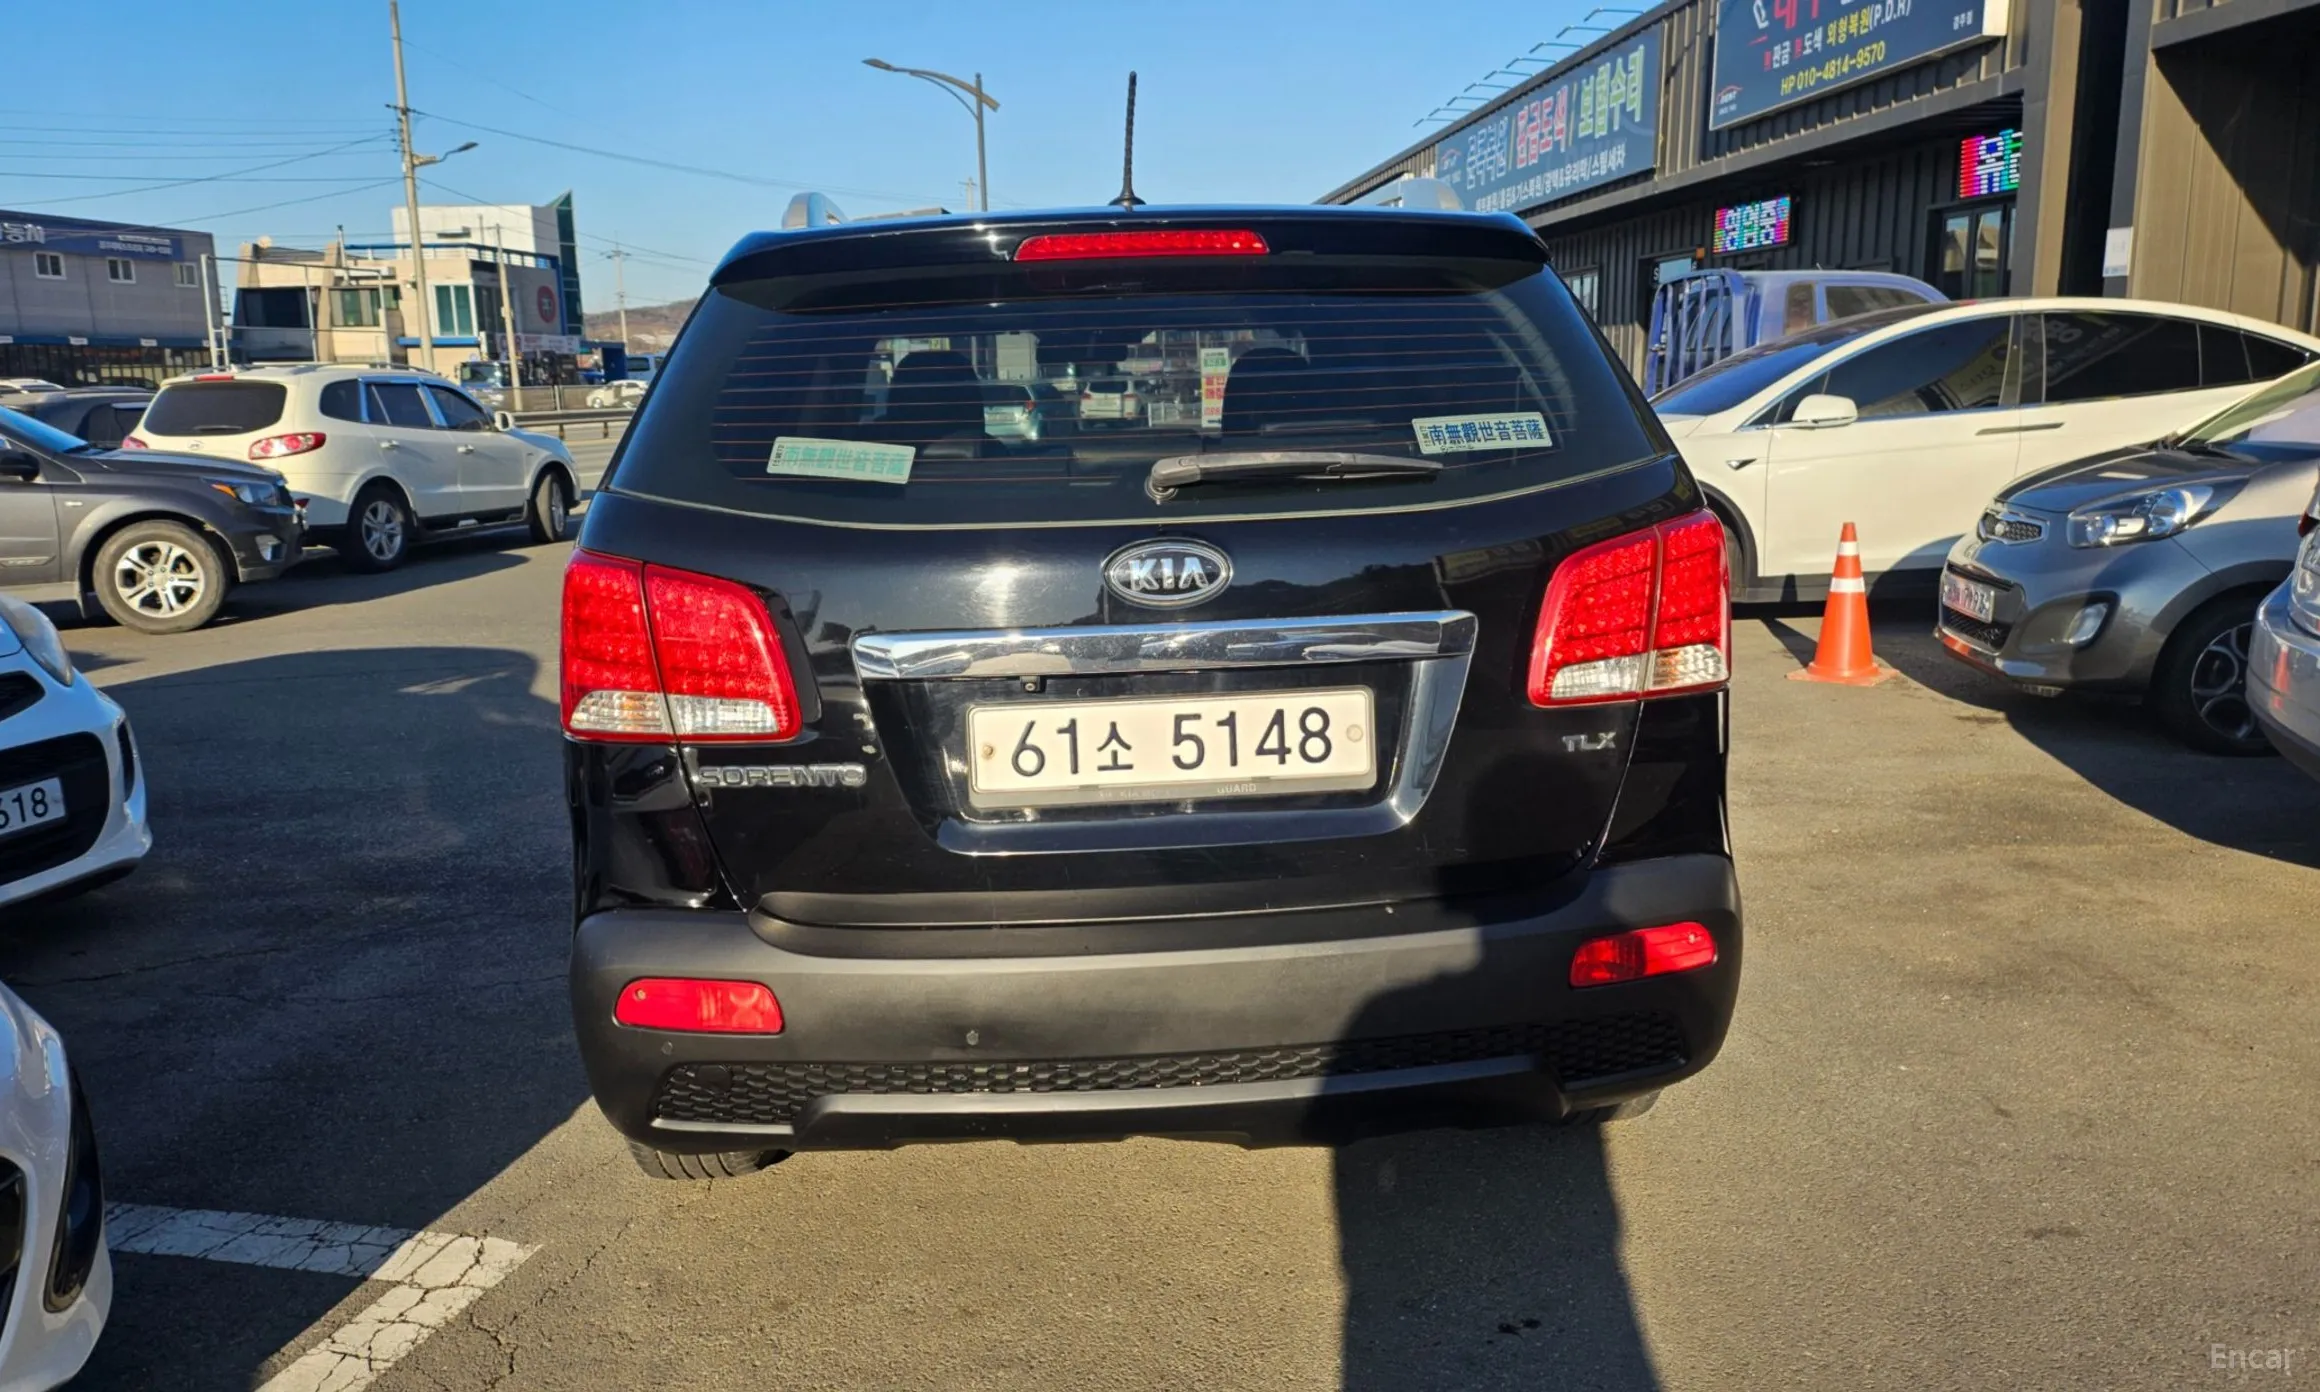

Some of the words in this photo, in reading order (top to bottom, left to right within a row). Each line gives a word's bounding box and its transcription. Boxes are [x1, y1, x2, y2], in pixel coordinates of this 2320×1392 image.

[1803, 26, 1823, 56] 도색
[1780, 72, 1796, 96] HP
[1796, 41, 1886, 90] 010-4814-9570
[1578, 43, 1645, 139] 보험수리
[1128, 556, 1209, 591] KIA
[1011, 717, 1134, 777] 61소
[1171, 706, 1332, 770] 5148
[1562, 732, 1617, 752] TLX
[699, 763, 867, 787] SORENTO
